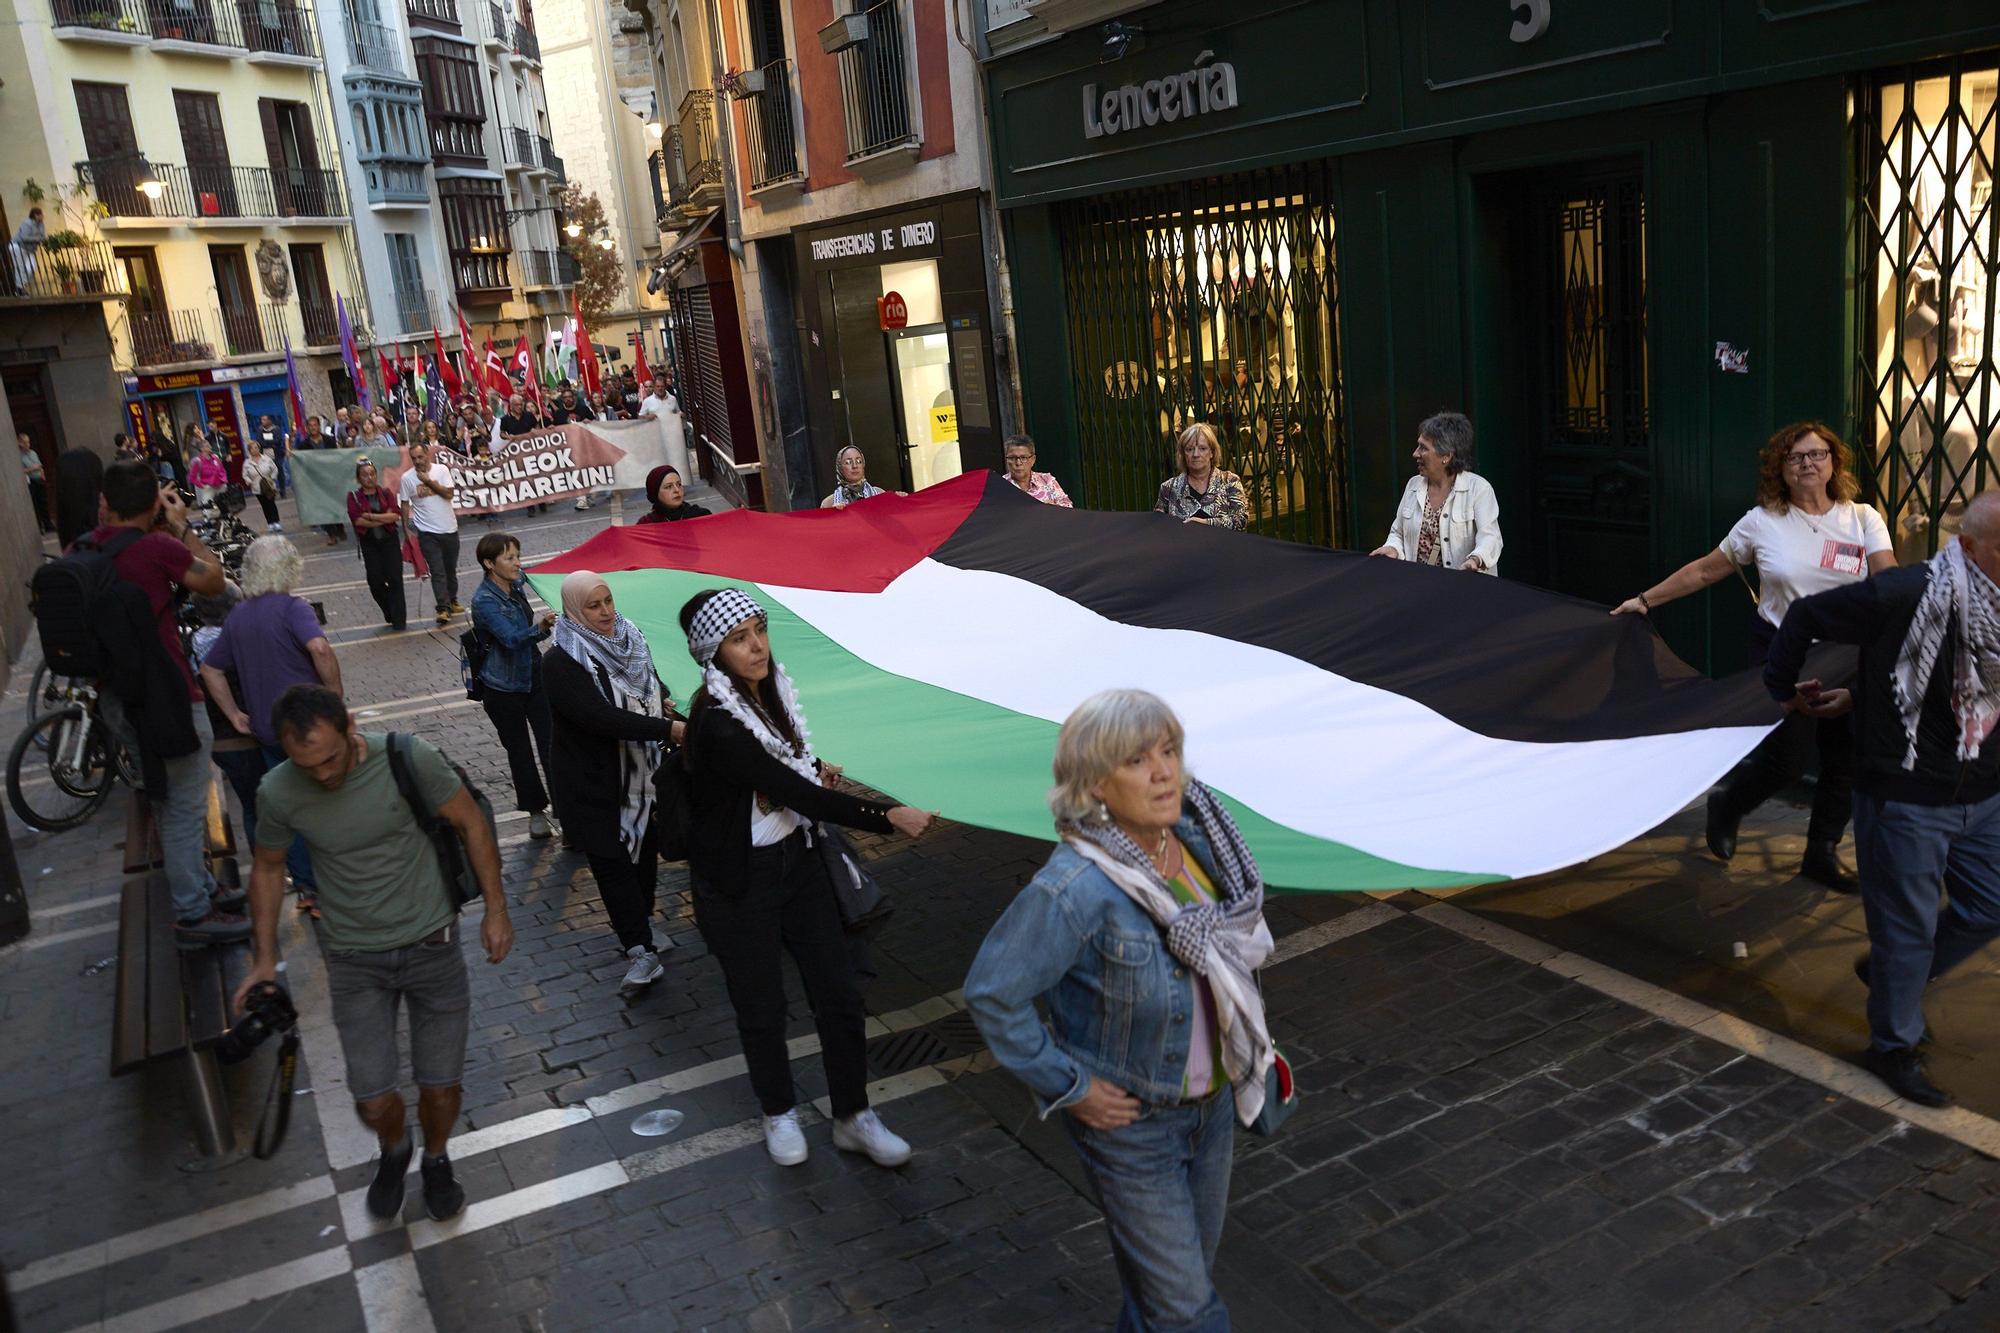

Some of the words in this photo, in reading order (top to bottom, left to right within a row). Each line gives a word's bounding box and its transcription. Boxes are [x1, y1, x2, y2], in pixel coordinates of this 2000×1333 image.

[1083, 49, 1238, 139] Lencería
[811, 232, 875, 260] TRANSFERENCIAS
[881, 229, 894, 251] DE
[901, 221, 935, 248] DINERO
[886, 296, 905, 319] ria
[450, 448, 575, 487] ANGILEOK
[451, 465, 614, 509] ESTINAREKIN!
